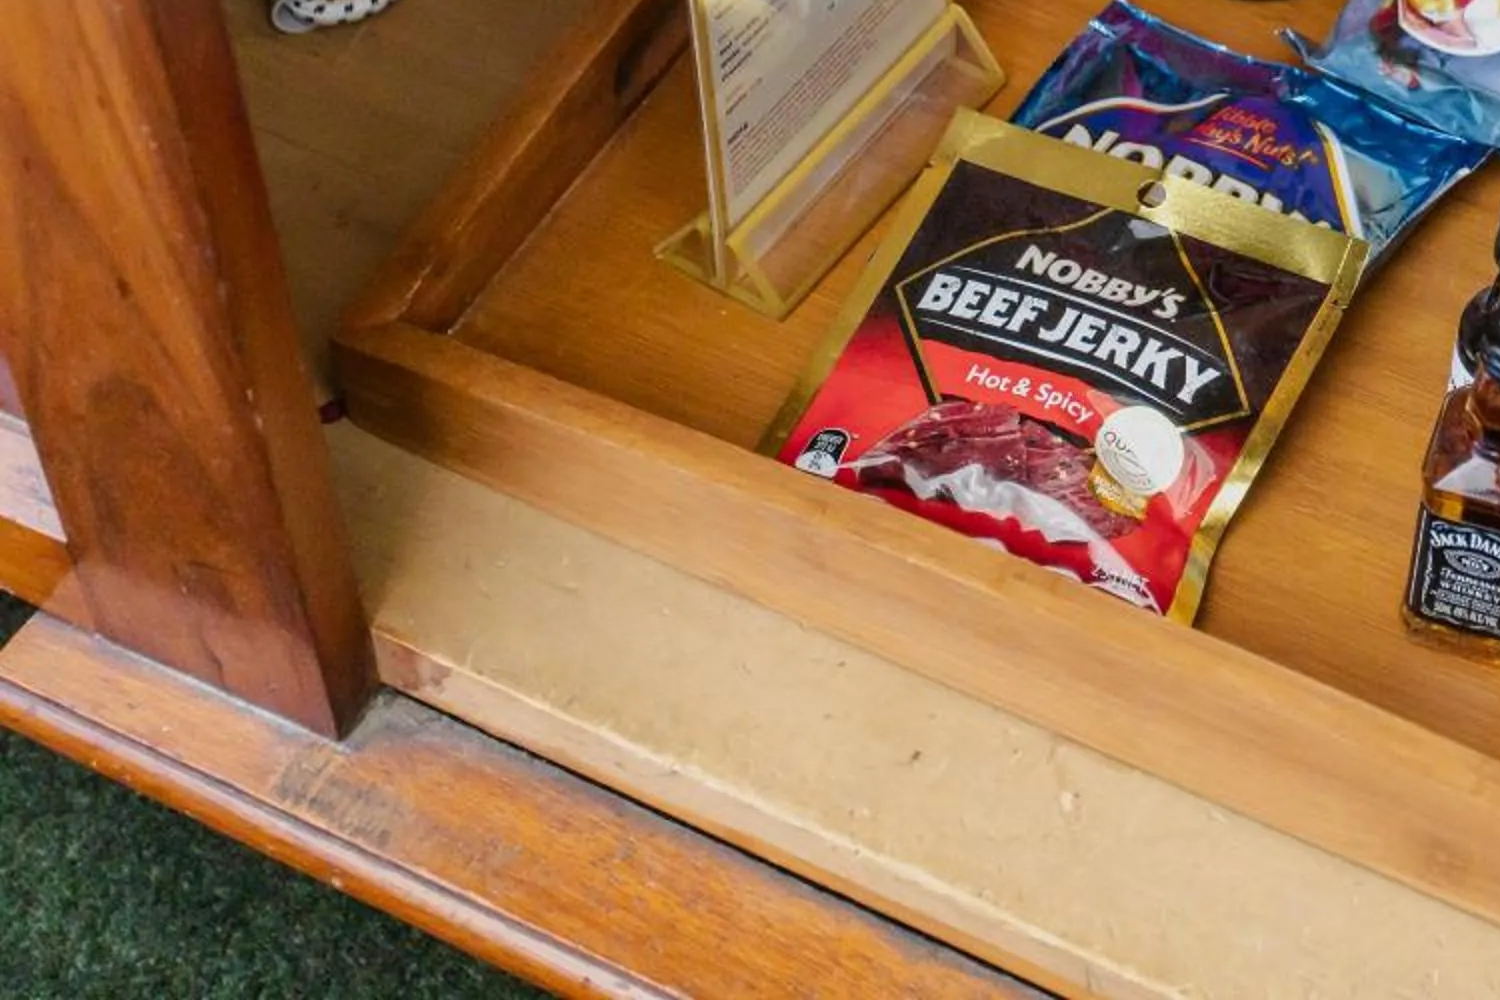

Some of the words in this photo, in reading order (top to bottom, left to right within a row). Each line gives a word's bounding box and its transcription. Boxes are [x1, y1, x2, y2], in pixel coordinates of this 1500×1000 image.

[916, 273, 1049, 332] BEEF
[1038, 307, 1221, 405] JERKY
[966, 364, 1011, 392] Hot
[1012, 378, 1031, 397] &
[1034, 383, 1095, 425] Spicy
[1430, 530, 1468, 548] JACK
